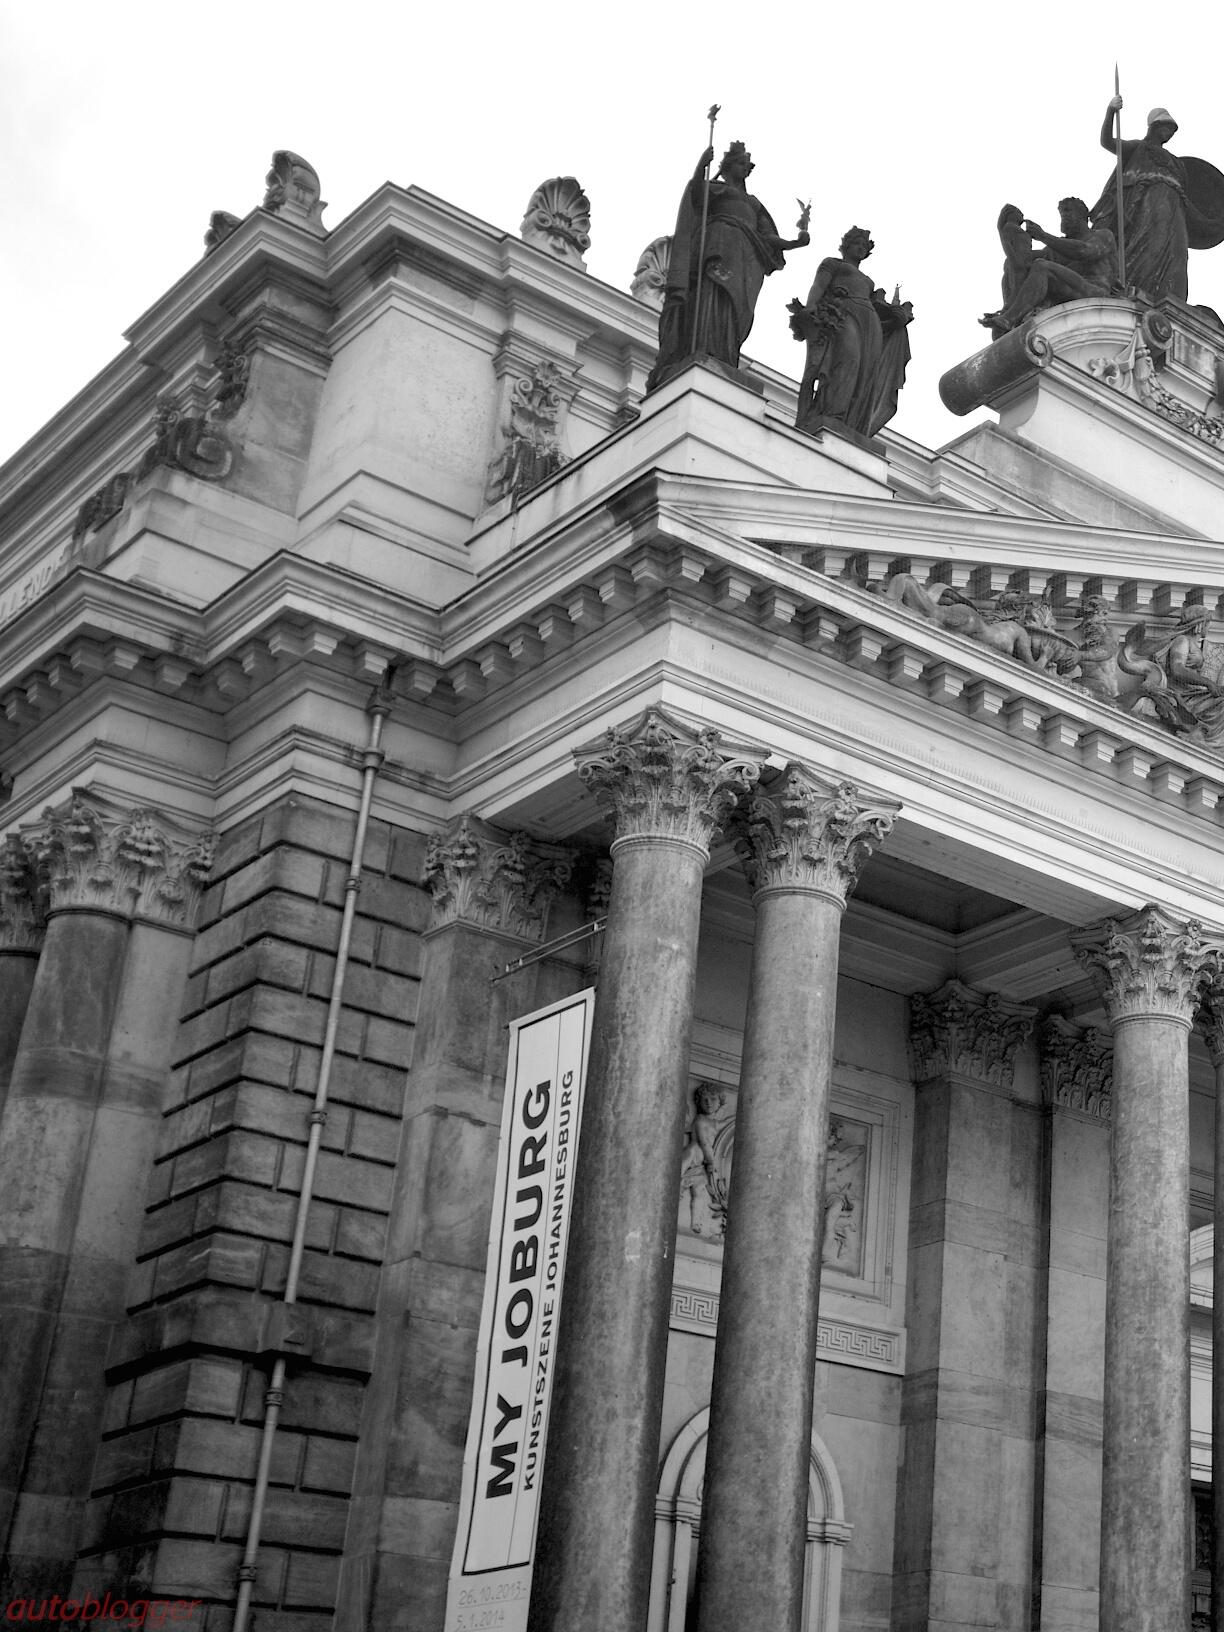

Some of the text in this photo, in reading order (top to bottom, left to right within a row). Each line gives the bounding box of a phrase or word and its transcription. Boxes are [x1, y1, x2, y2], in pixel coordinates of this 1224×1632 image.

[485, 1079, 551, 1499] MY JOBURG
[523, 1069, 574, 1491] KUNSTSZENE JOHANNESBURG
